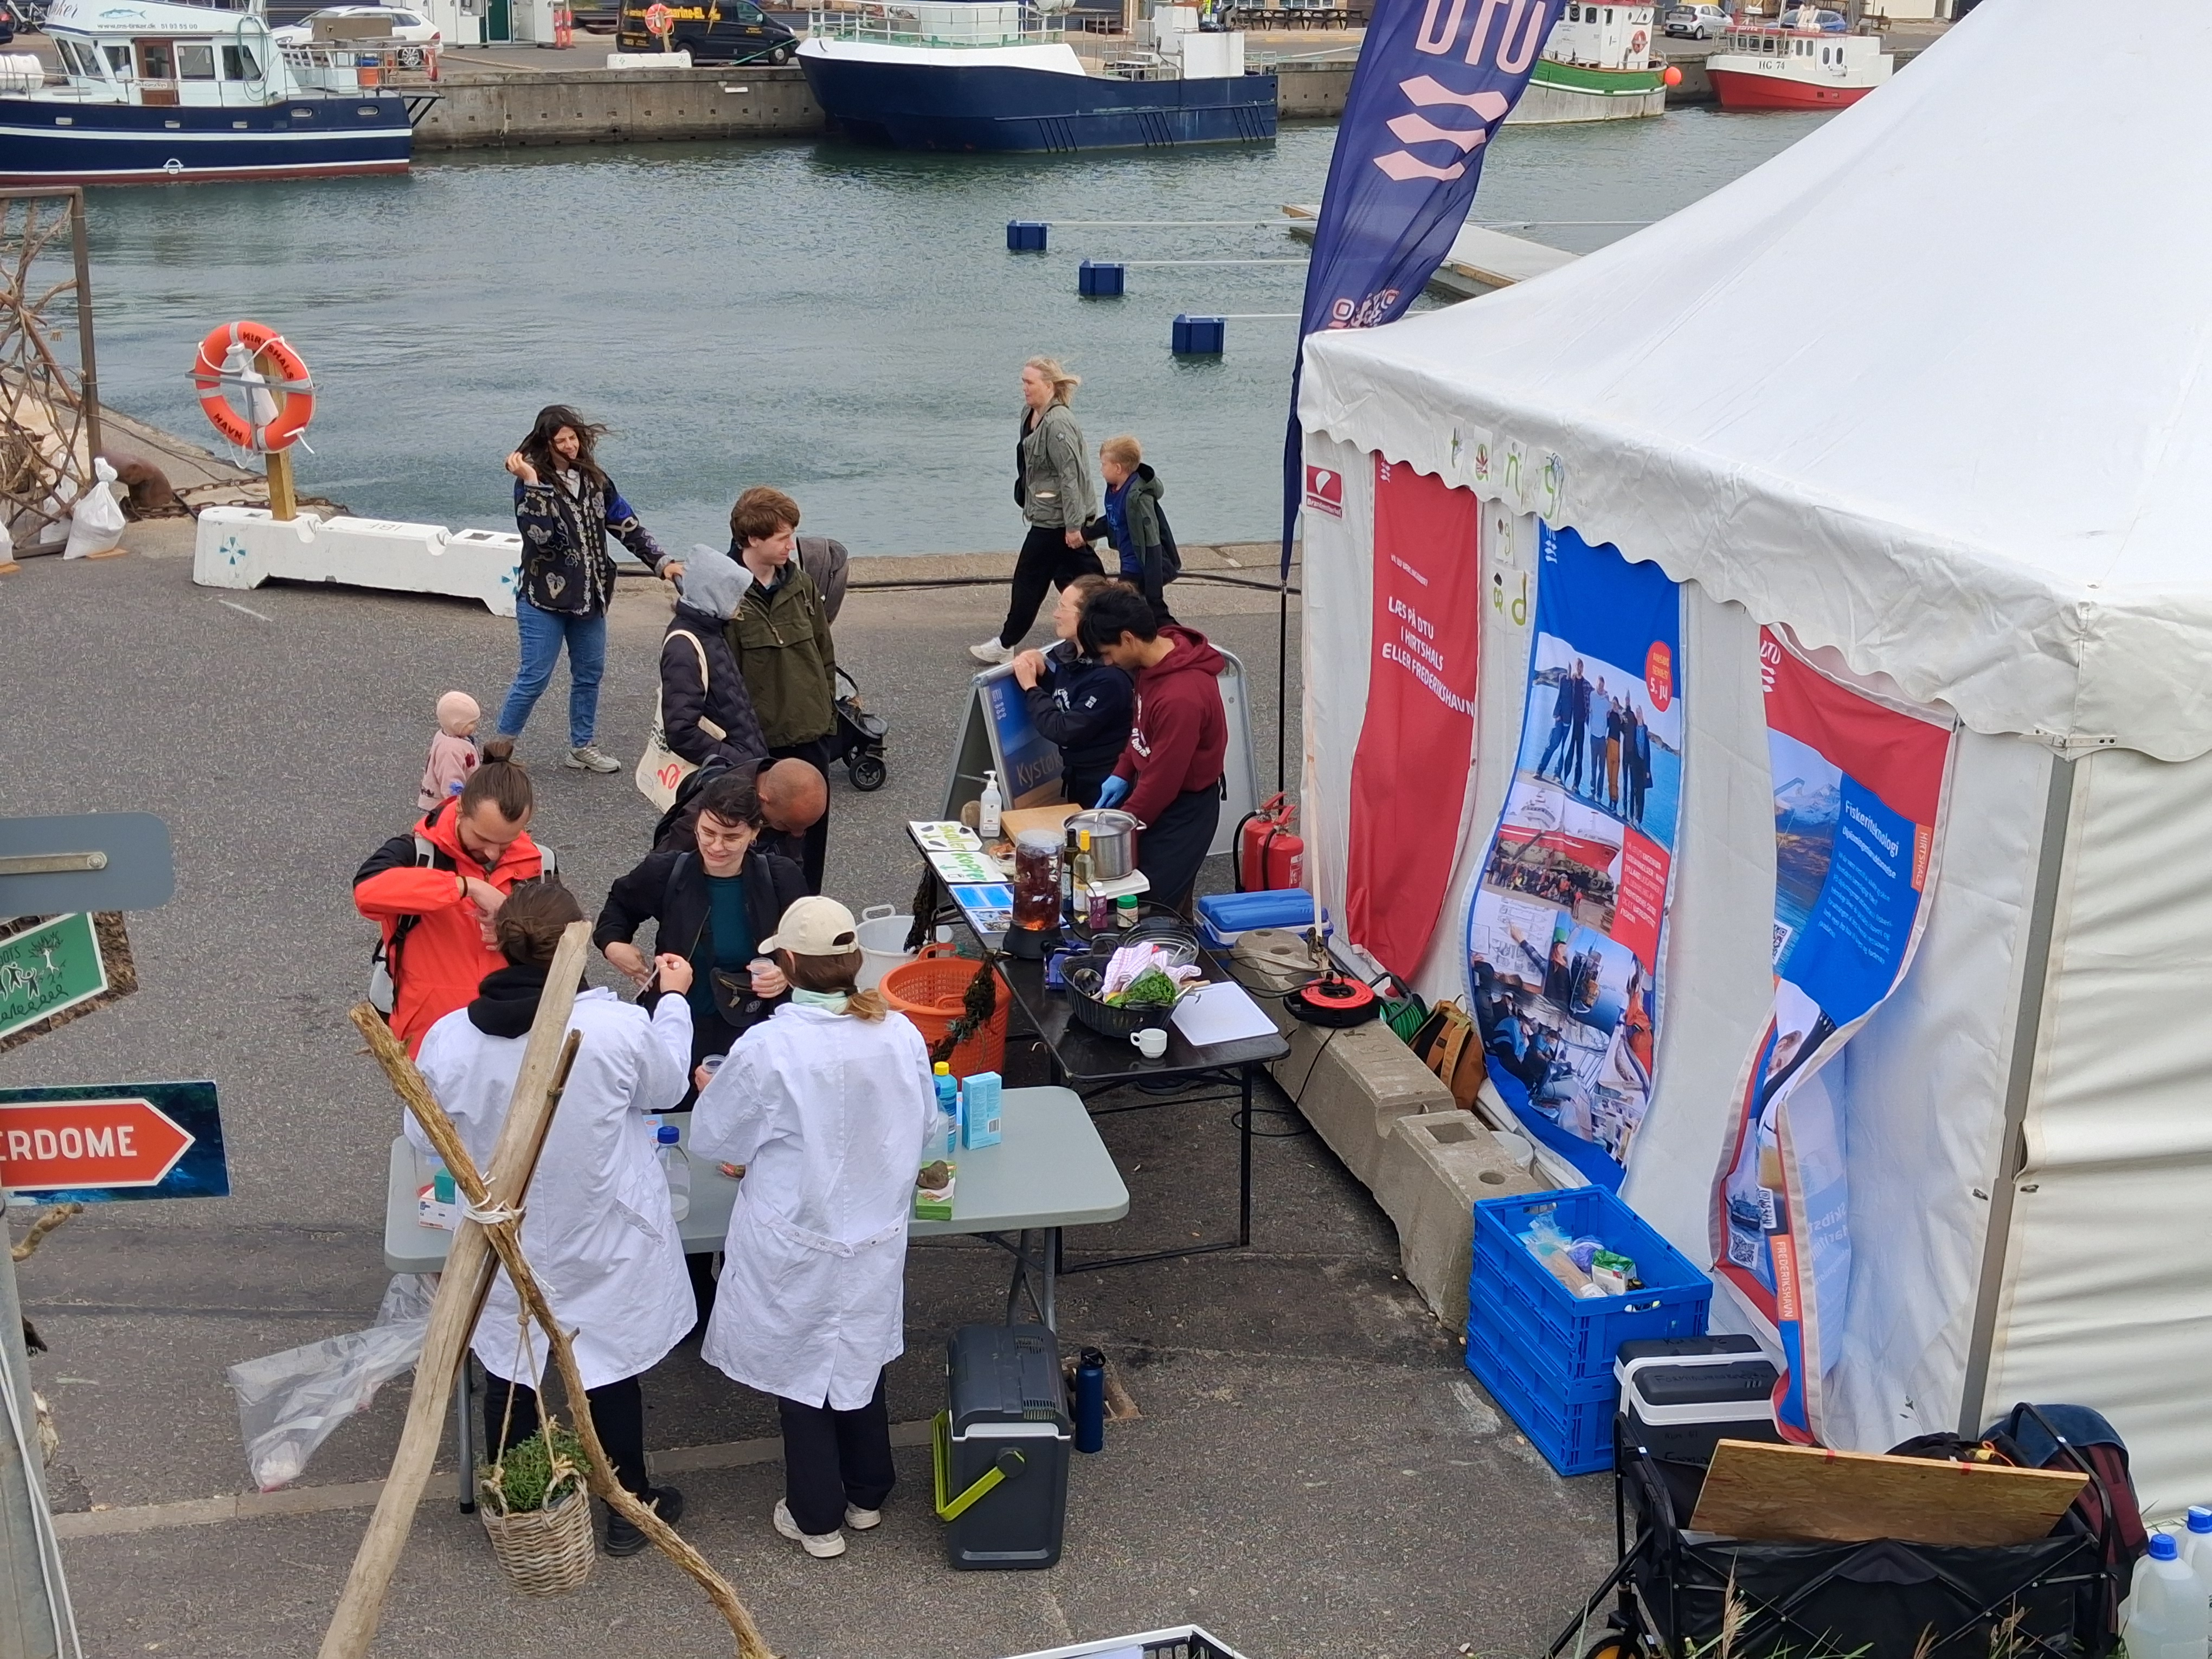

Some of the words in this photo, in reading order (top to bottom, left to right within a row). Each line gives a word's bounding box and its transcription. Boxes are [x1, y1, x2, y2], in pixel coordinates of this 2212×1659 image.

[1416, 0, 1546, 74] DTU
[243, 331, 294, 380] HIRSHALS
[213, 413, 243, 441] HAVN
[1388, 596, 1407, 620] LÆS
[1408, 606, 1417, 629] PÅ
[1417, 616, 1435, 640] DTU
[1400, 625, 1404, 642] I
[1405, 628, 1444, 672] HIRTSHALS
[1382, 642, 1412, 671] ELLER
[1411, 658, 1475, 719] FREDERIKSHAVN
[1776, 1240, 1794, 1319] FREDERIKSHAVN
